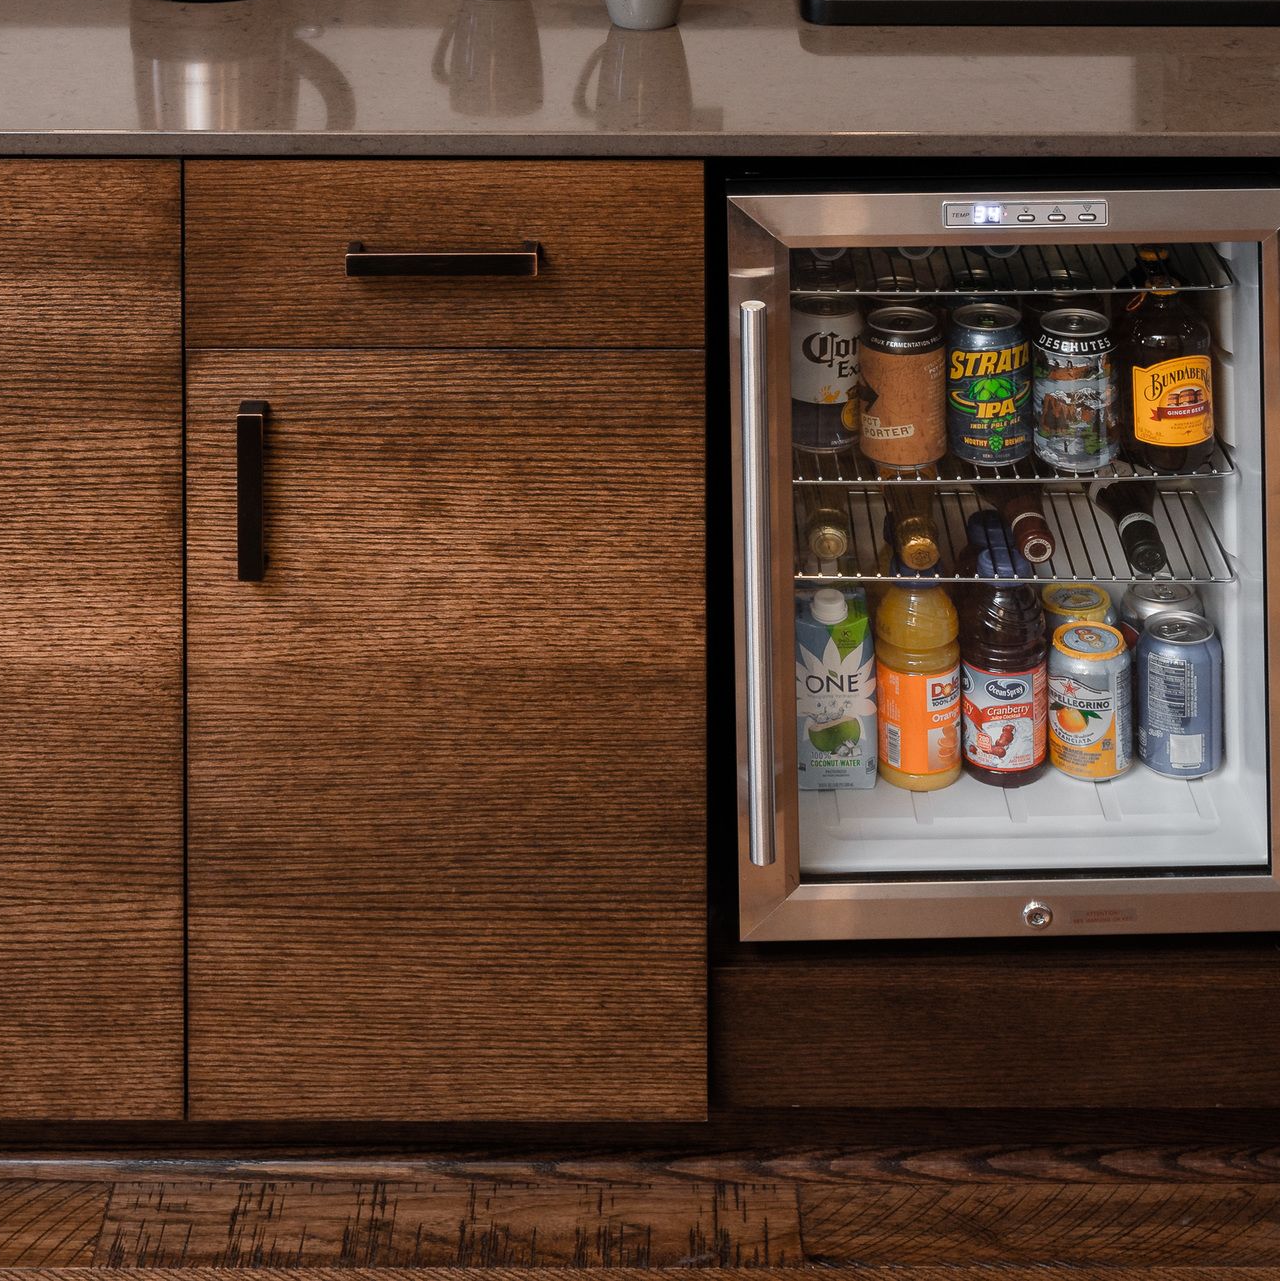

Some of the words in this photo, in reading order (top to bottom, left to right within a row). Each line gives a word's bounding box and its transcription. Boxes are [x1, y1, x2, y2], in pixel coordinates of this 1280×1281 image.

[885, 340, 931, 349] FERMENTATION
[1039, 334, 1111, 352] DESCHUTES
[802, 331, 859, 368] Cor
[949, 342, 1030, 380] STRATA
[975, 398, 1017, 419] IPA
[1166, 408, 1191, 416] GINGER
[1191, 405, 1205, 414] BEER
[864, 426, 909, 437] PORTER
[963, 436, 988, 447] WORTHY
[805, 673, 859, 694] ONE
[988, 684, 1007, 697] Ocean
[1006, 685, 1023, 698] Spray
[932, 699, 948, 707] 100%
[987, 705, 1030, 716] Cranberry
[811, 751, 832, 759] 100%
[810, 759, 838, 767] COCONUT
[840, 759, 861, 767] WATER
